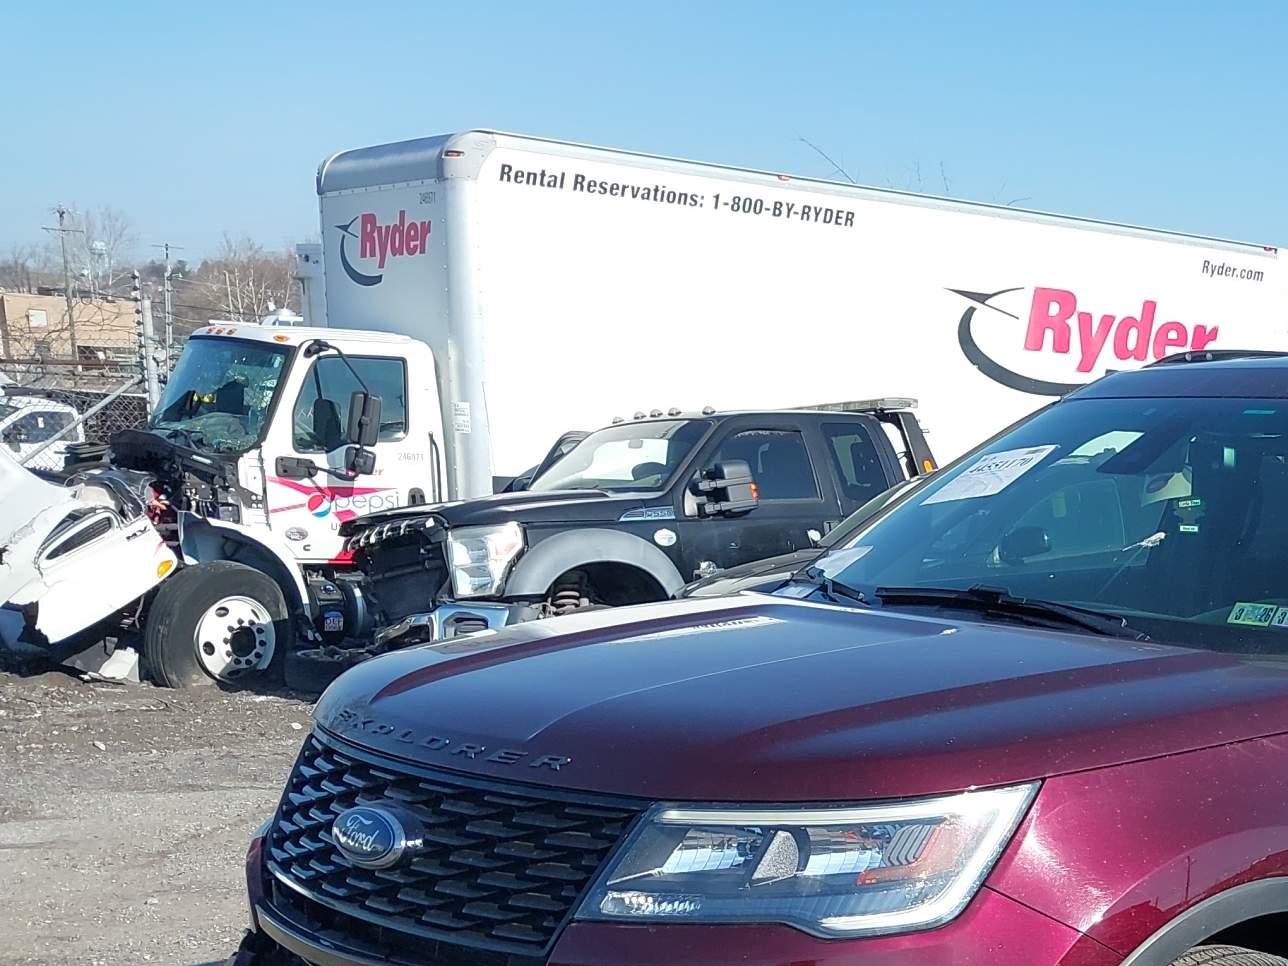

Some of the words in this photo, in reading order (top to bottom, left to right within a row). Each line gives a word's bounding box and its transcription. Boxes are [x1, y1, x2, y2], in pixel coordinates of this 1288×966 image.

[499, 163, 566, 189] Rental
[573, 173, 705, 208] Reservations:
[712, 193, 856, 227] 1-800-BY-RYDER
[360, 209, 432, 269] Ryder
[1202, 259, 1265, 282] Ryder.com
[1024, 287, 1219, 373] Ryder
[334, 491, 400, 513] pepsi
[336, 707, 572, 773] EXPLORER
[345, 813, 382, 852] Ford
